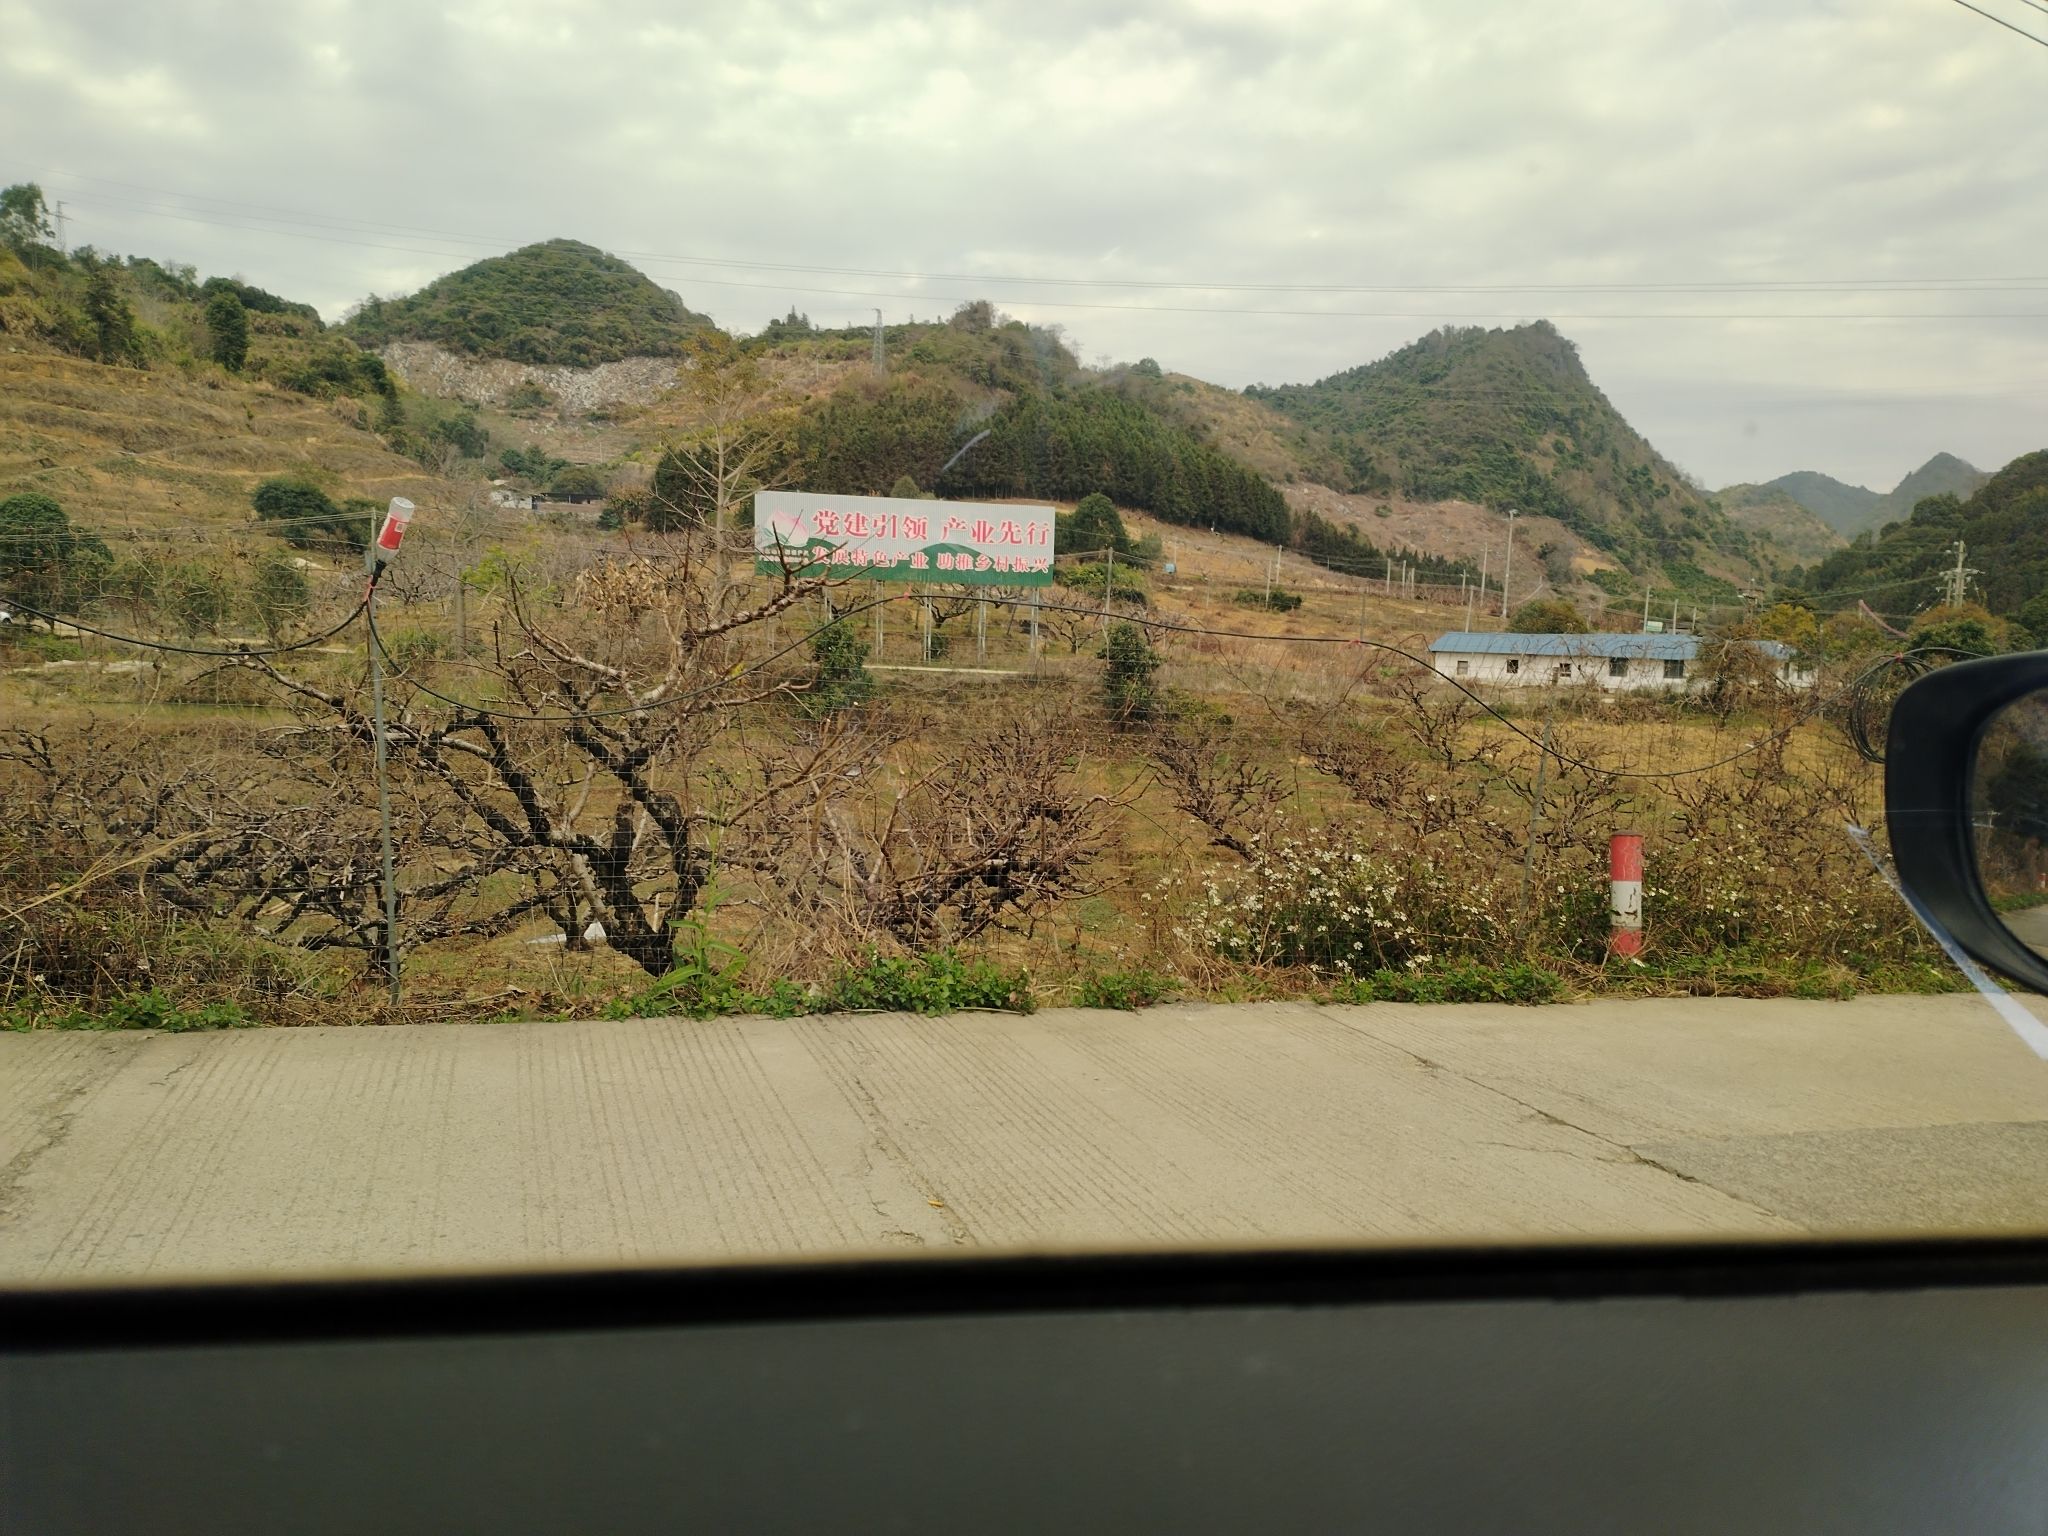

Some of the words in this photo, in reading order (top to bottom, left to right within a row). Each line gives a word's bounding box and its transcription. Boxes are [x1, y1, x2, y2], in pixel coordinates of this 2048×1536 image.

[812, 509, 929, 541] 党建引领
[939, 516, 1050, 546] 产业先行
[936, 552, 1049, 574] 助推乡村振兴
